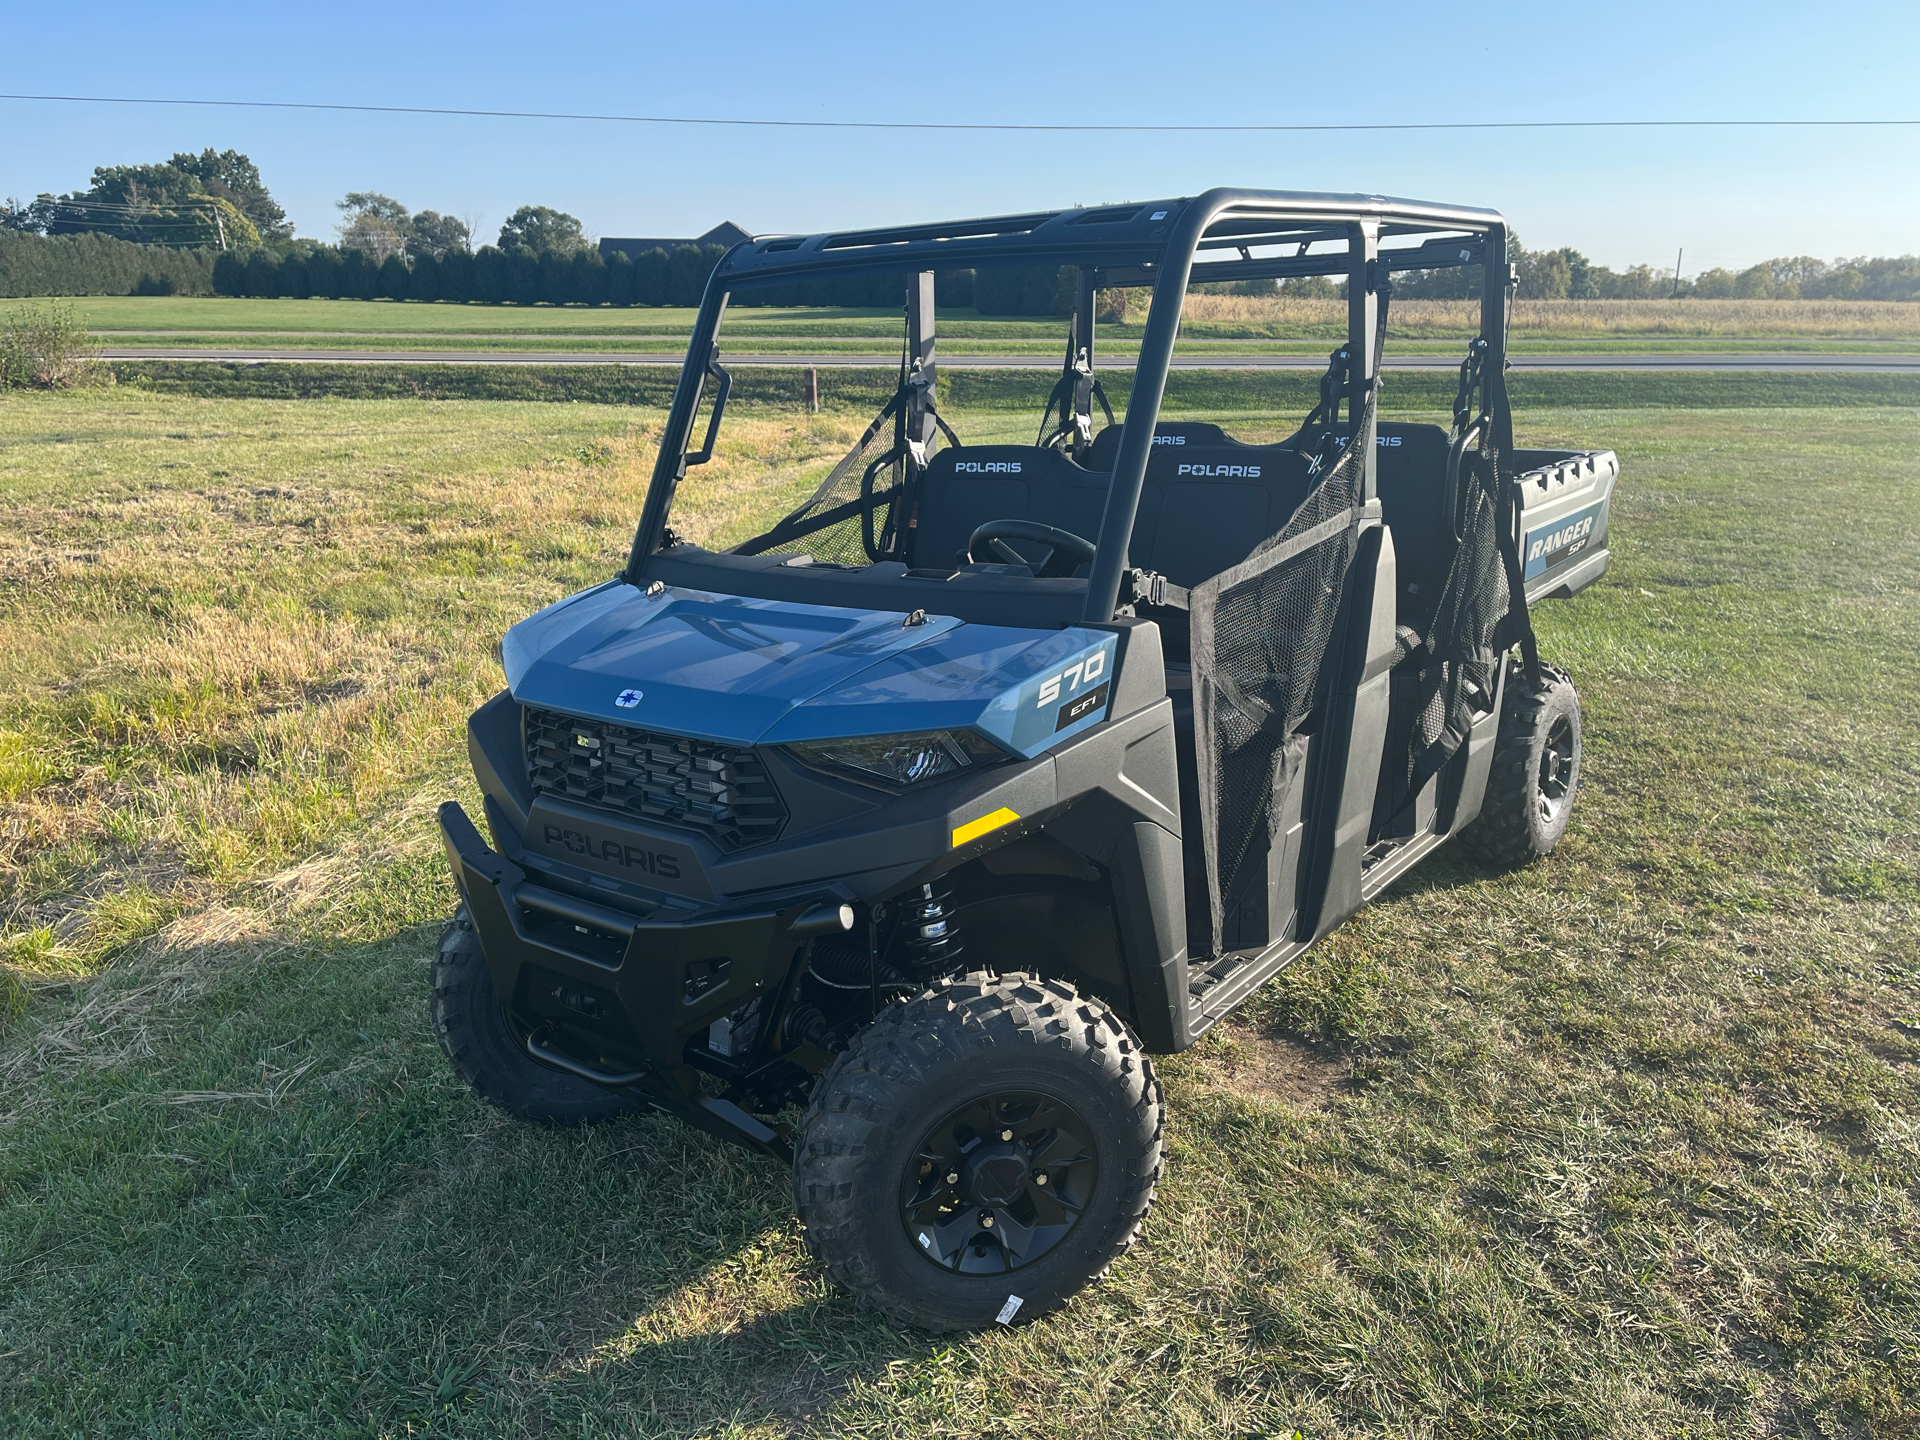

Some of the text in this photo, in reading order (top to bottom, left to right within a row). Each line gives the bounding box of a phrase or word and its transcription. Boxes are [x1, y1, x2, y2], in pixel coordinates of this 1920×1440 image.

[1151, 435, 1186, 445] ARIS
[955, 462, 1022, 473] POLARIS
[1177, 464, 1261, 478] POLARIS
[1528, 516, 1593, 562] RANGER
[1567, 538, 1586, 556] SP
[1037, 650, 1105, 709] 570
[1070, 695, 1097, 717] EFI
[543, 822, 681, 880] POLARIS
